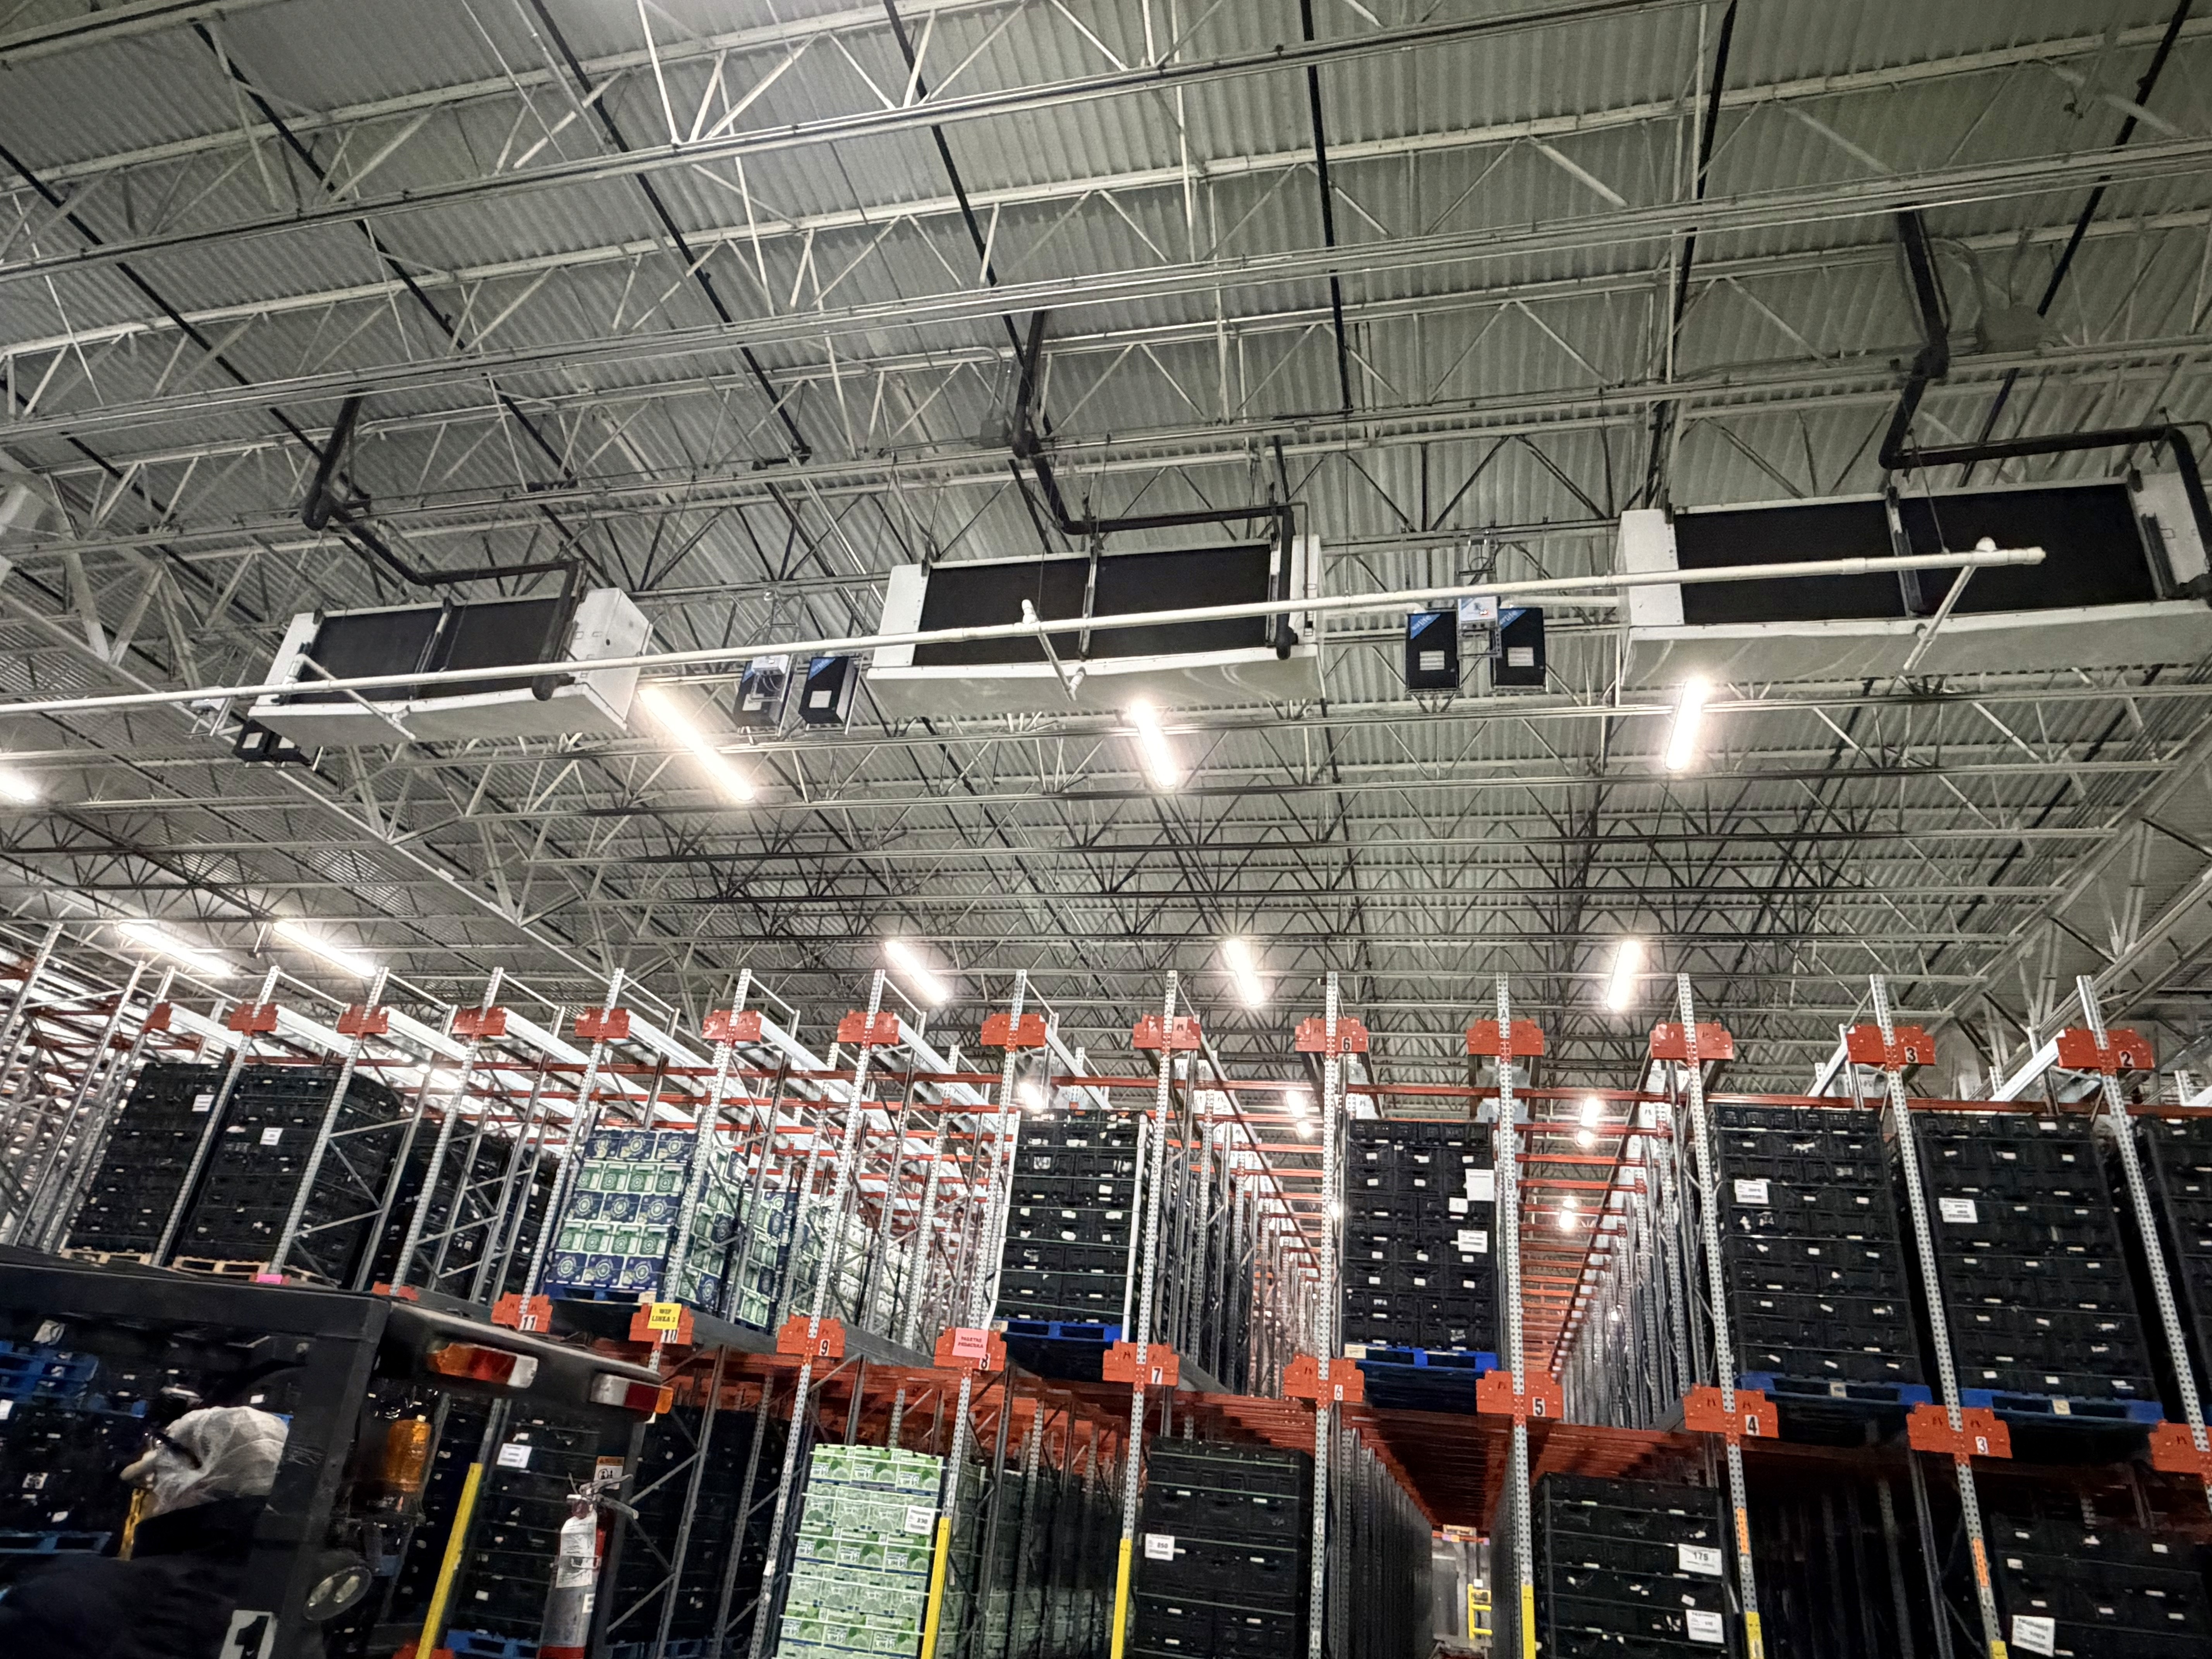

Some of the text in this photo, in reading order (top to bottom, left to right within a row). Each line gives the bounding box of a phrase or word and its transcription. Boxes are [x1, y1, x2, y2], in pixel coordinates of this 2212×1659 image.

[1501, 1009, 1507, 1019] A
[1343, 1037, 1350, 1050] 6
[1906, 1047, 1916, 1062] 3
[2121, 1051, 2133, 1066] 2
[1508, 1179, 1513, 1190] B
[523, 1316, 536, 1329] 11
[665, 1329, 677, 1342] 10
[821, 1340, 828, 1355] 9
[981, 1354, 989, 1369] 8
[1154, 1368, 1161, 1384] 7
[1336, 1386, 1341, 1399] 6
[1535, 1398, 1543, 1415] 5
[1748, 1416, 1757, 1434] 4
[1978, 1438, 1986, 1453] 3
[582, 1593, 595, 1614] E
[234, 1616, 270, 1659] 1
